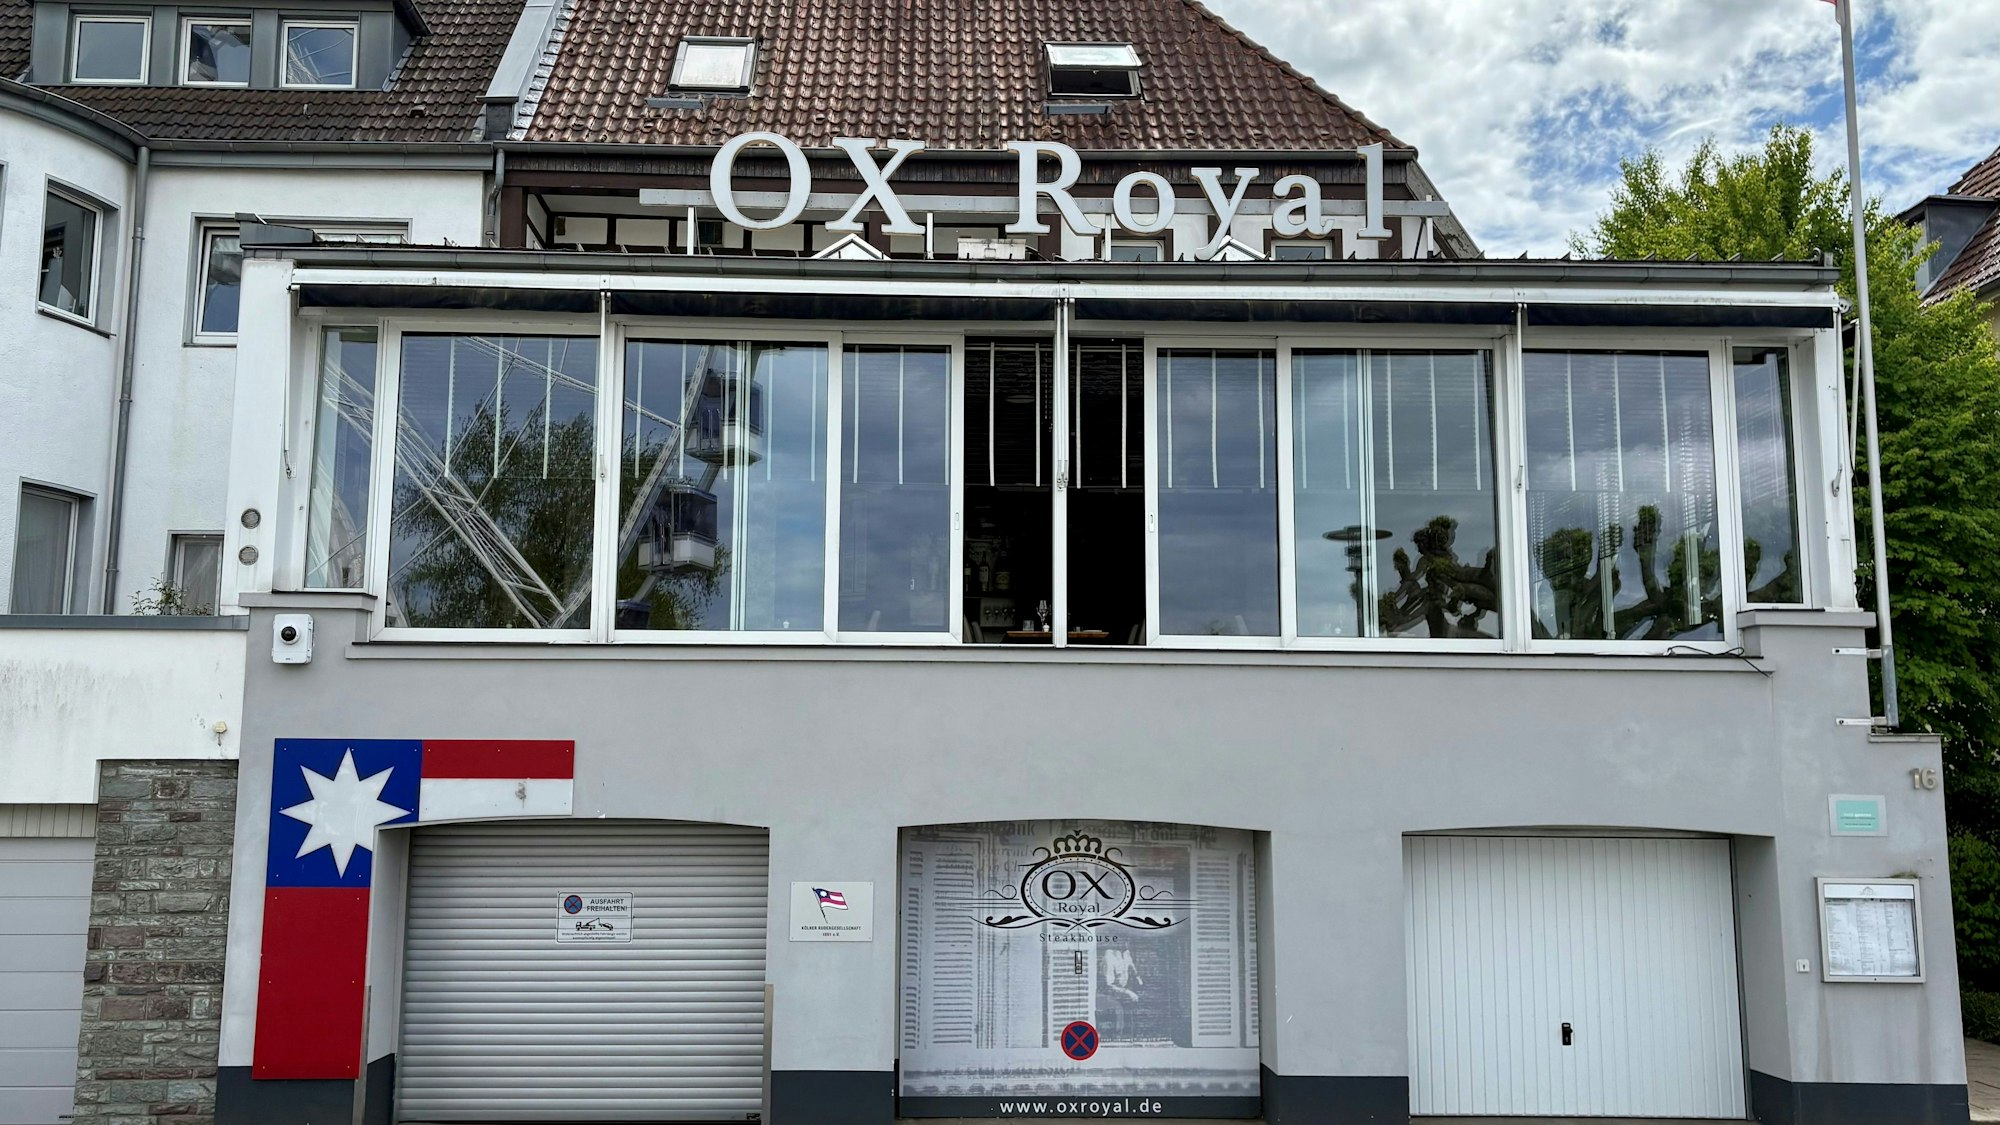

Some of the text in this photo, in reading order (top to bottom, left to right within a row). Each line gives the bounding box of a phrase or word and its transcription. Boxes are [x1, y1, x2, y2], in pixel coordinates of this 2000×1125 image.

[709, 131, 1393, 261] OX Royal
[1910, 767, 1938, 790] 16
[1042, 870, 1114, 900] OX
[1058, 902, 1100, 915] Royal
[1040, 932, 1118, 943] Steakhouse
[1000, 1098, 1162, 1116] www.oxroyal.de
